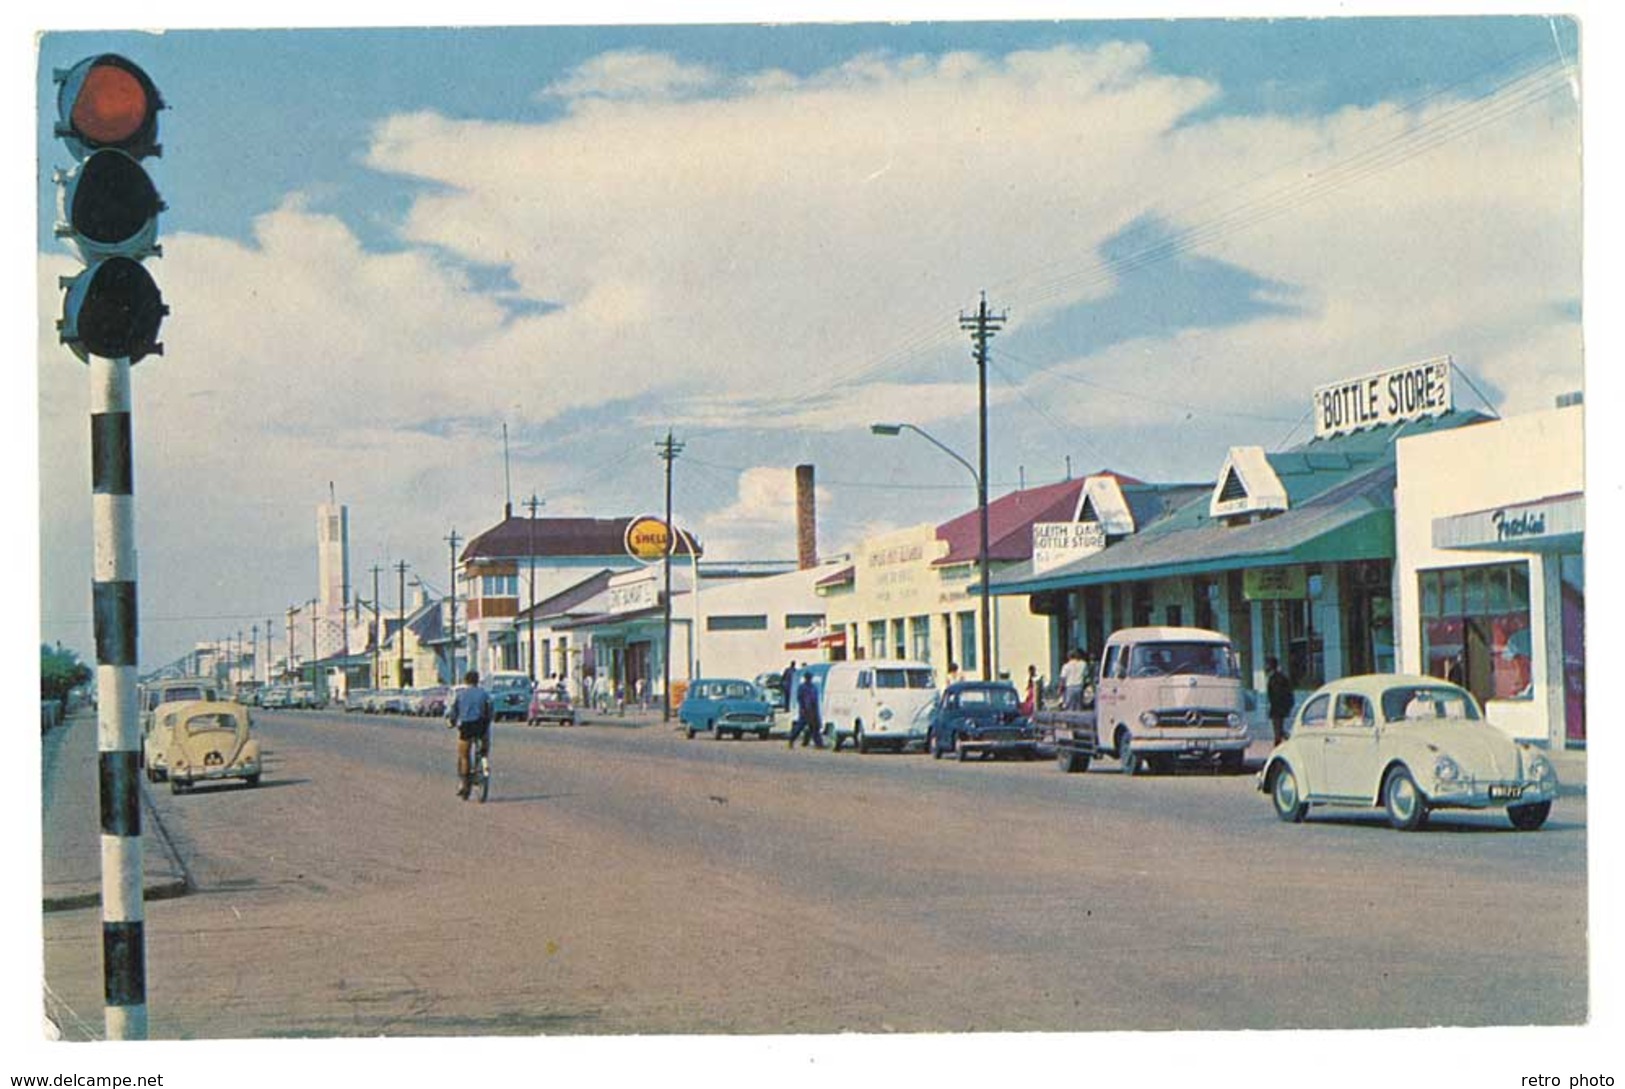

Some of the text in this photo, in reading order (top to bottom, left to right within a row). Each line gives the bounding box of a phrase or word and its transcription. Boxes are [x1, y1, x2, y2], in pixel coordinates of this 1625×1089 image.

[1323, 366, 1436, 430] BOTTLE STORE
[635, 533, 667, 545] SHELL
[1071, 536, 1105, 549] STORE
